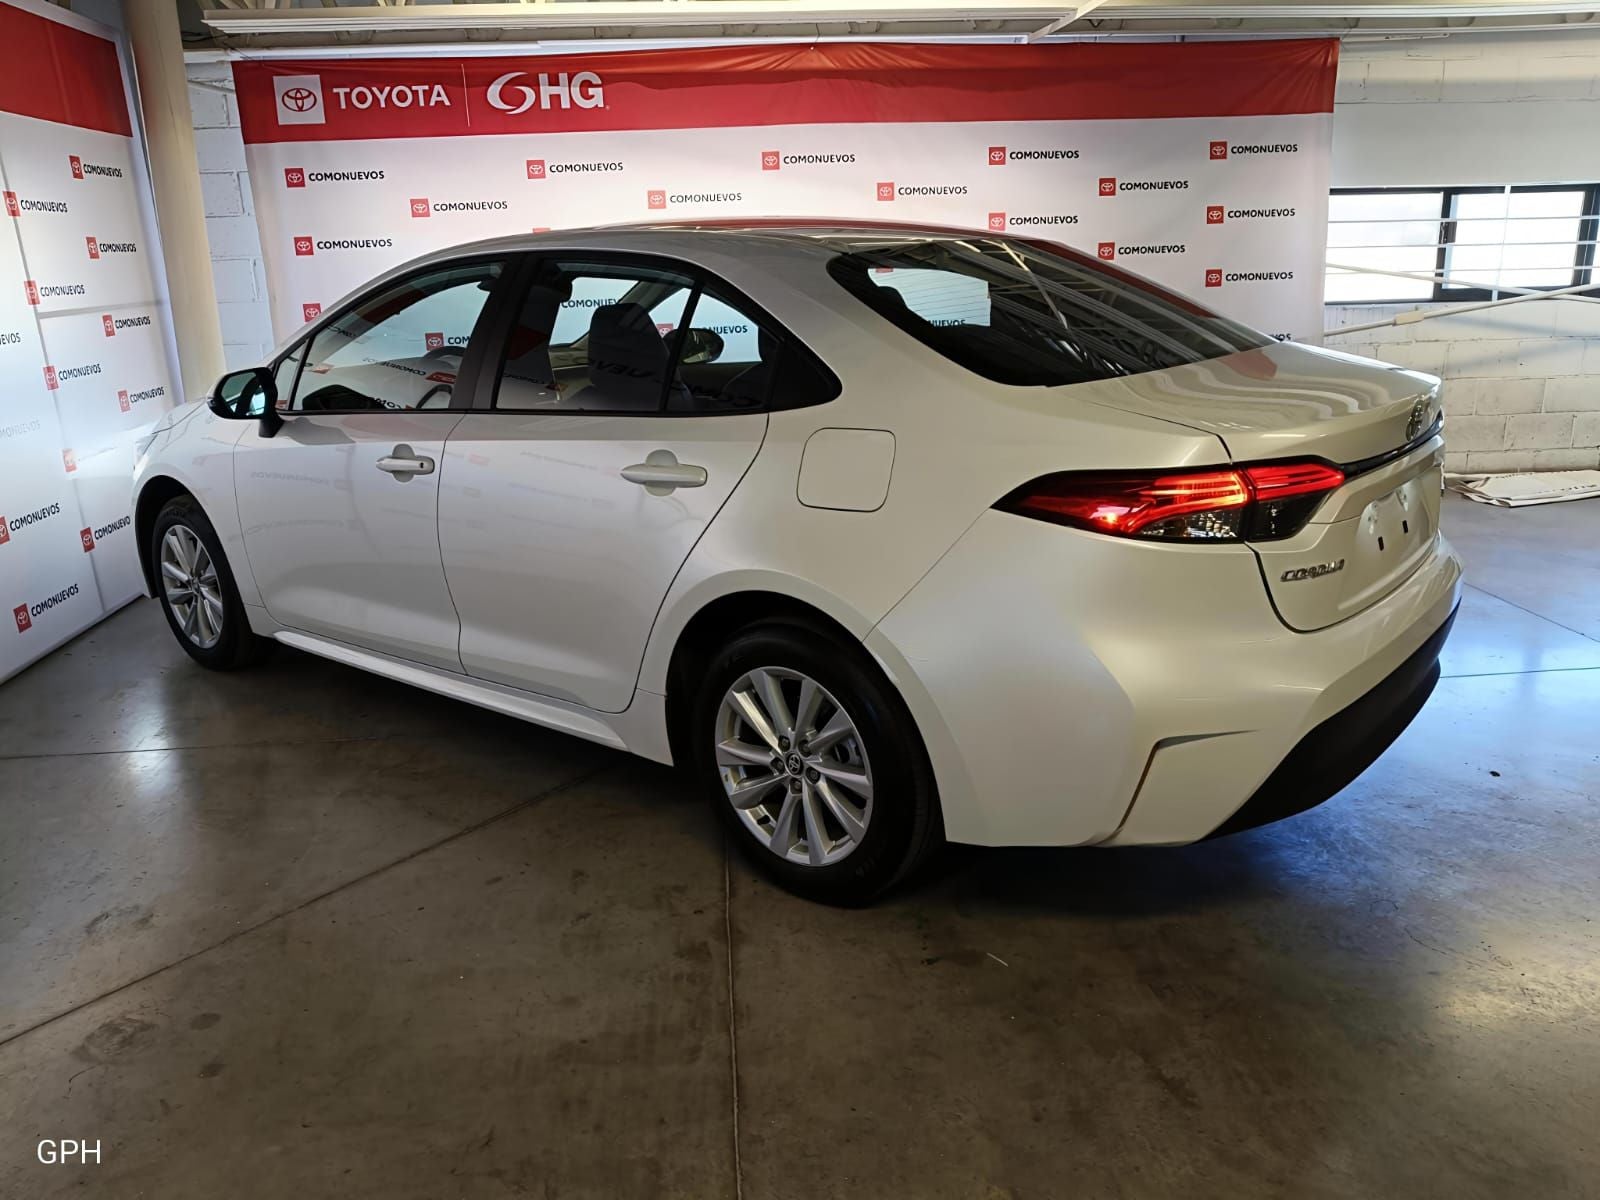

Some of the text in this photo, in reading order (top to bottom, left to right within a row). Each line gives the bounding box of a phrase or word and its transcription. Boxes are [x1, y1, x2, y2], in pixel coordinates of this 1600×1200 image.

[333, 84, 451, 109] TOYOTA
[1010, 149, 1080, 160] COMONUEVOS
[1231, 143, 1298, 155] COMONUEVOS
[783, 153, 856, 165] COMONUEVOS
[83, 162, 123, 179] COMONUEVOS
[549, 161, 624, 173] COMONUEVOS
[308, 170, 385, 182] COMONUEVOS
[898, 186, 968, 196] COMONUEVOS
[1119, 180, 1189, 191] COMONUEVOS
[669, 192, 742, 204] COMONUEVOS
[20, 199, 68, 214] COMONUEVOS
[433, 200, 508, 212] COMONUEVOS
[1228, 208, 1296, 219] COMONUEVOS
[1010, 215, 1079, 226] COMONUEVOS
[99, 243, 137, 254] COMONUEVOS
[316, 238, 393, 250] COMONUEVOS
[1118, 244, 1186, 256] COMONUEVOS
[1225, 271, 1294, 282] COMONUEVOS
[40, 284, 85, 297] COMONUEVOS
[114, 315, 151, 330] COMONUEVOS
[58, 363, 102, 381] COMONUEVOS
[130, 386, 165, 404] COMONUEVOS
[9, 503, 60, 532] COMONUEVOS
[94, 515, 131, 540] COMONUEVO
[31, 583, 79, 618] COMONUEVOS
